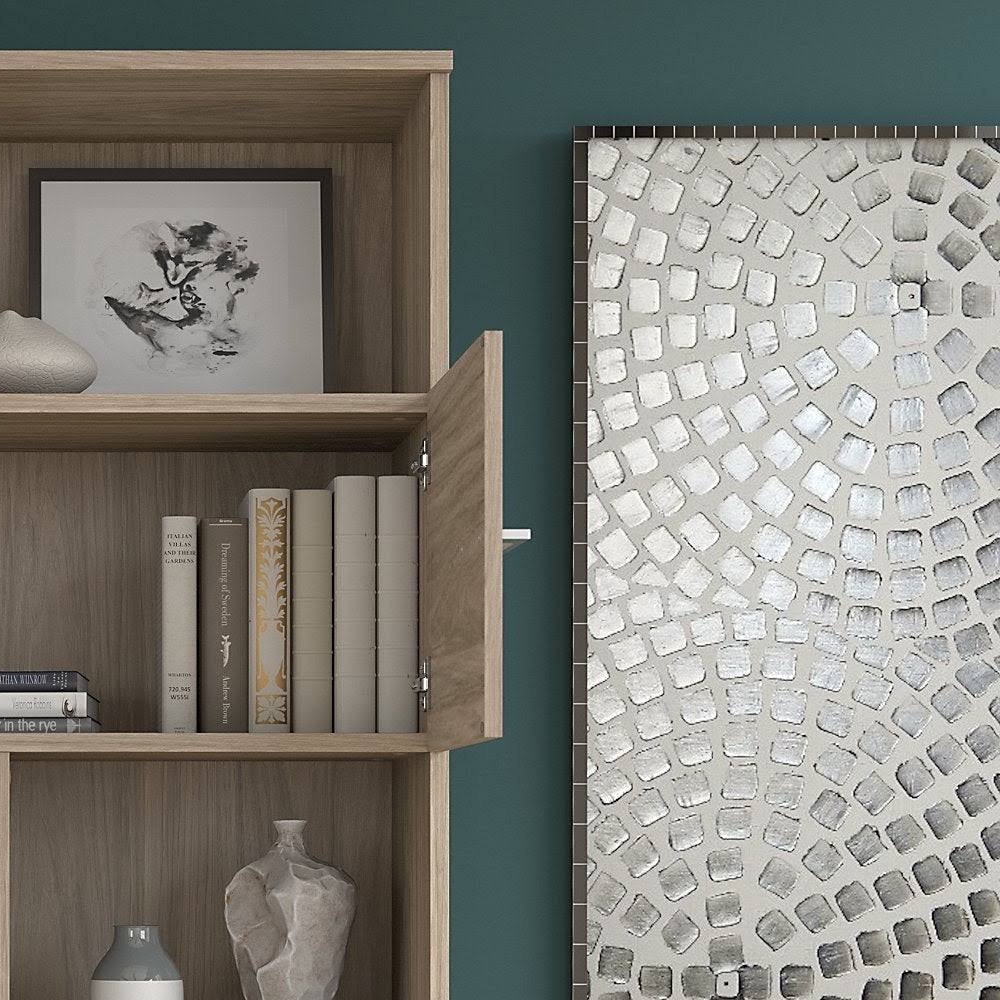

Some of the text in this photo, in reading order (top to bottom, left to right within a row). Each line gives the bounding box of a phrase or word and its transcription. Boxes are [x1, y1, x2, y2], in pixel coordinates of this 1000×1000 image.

[219, 543, 231, 626] Dreaming of Sweden
[222, 677, 231, 724] Andrew Brown
[3, 719, 14, 732] in
[17, 719, 36, 732] the
[39, 720, 57, 733] rye
